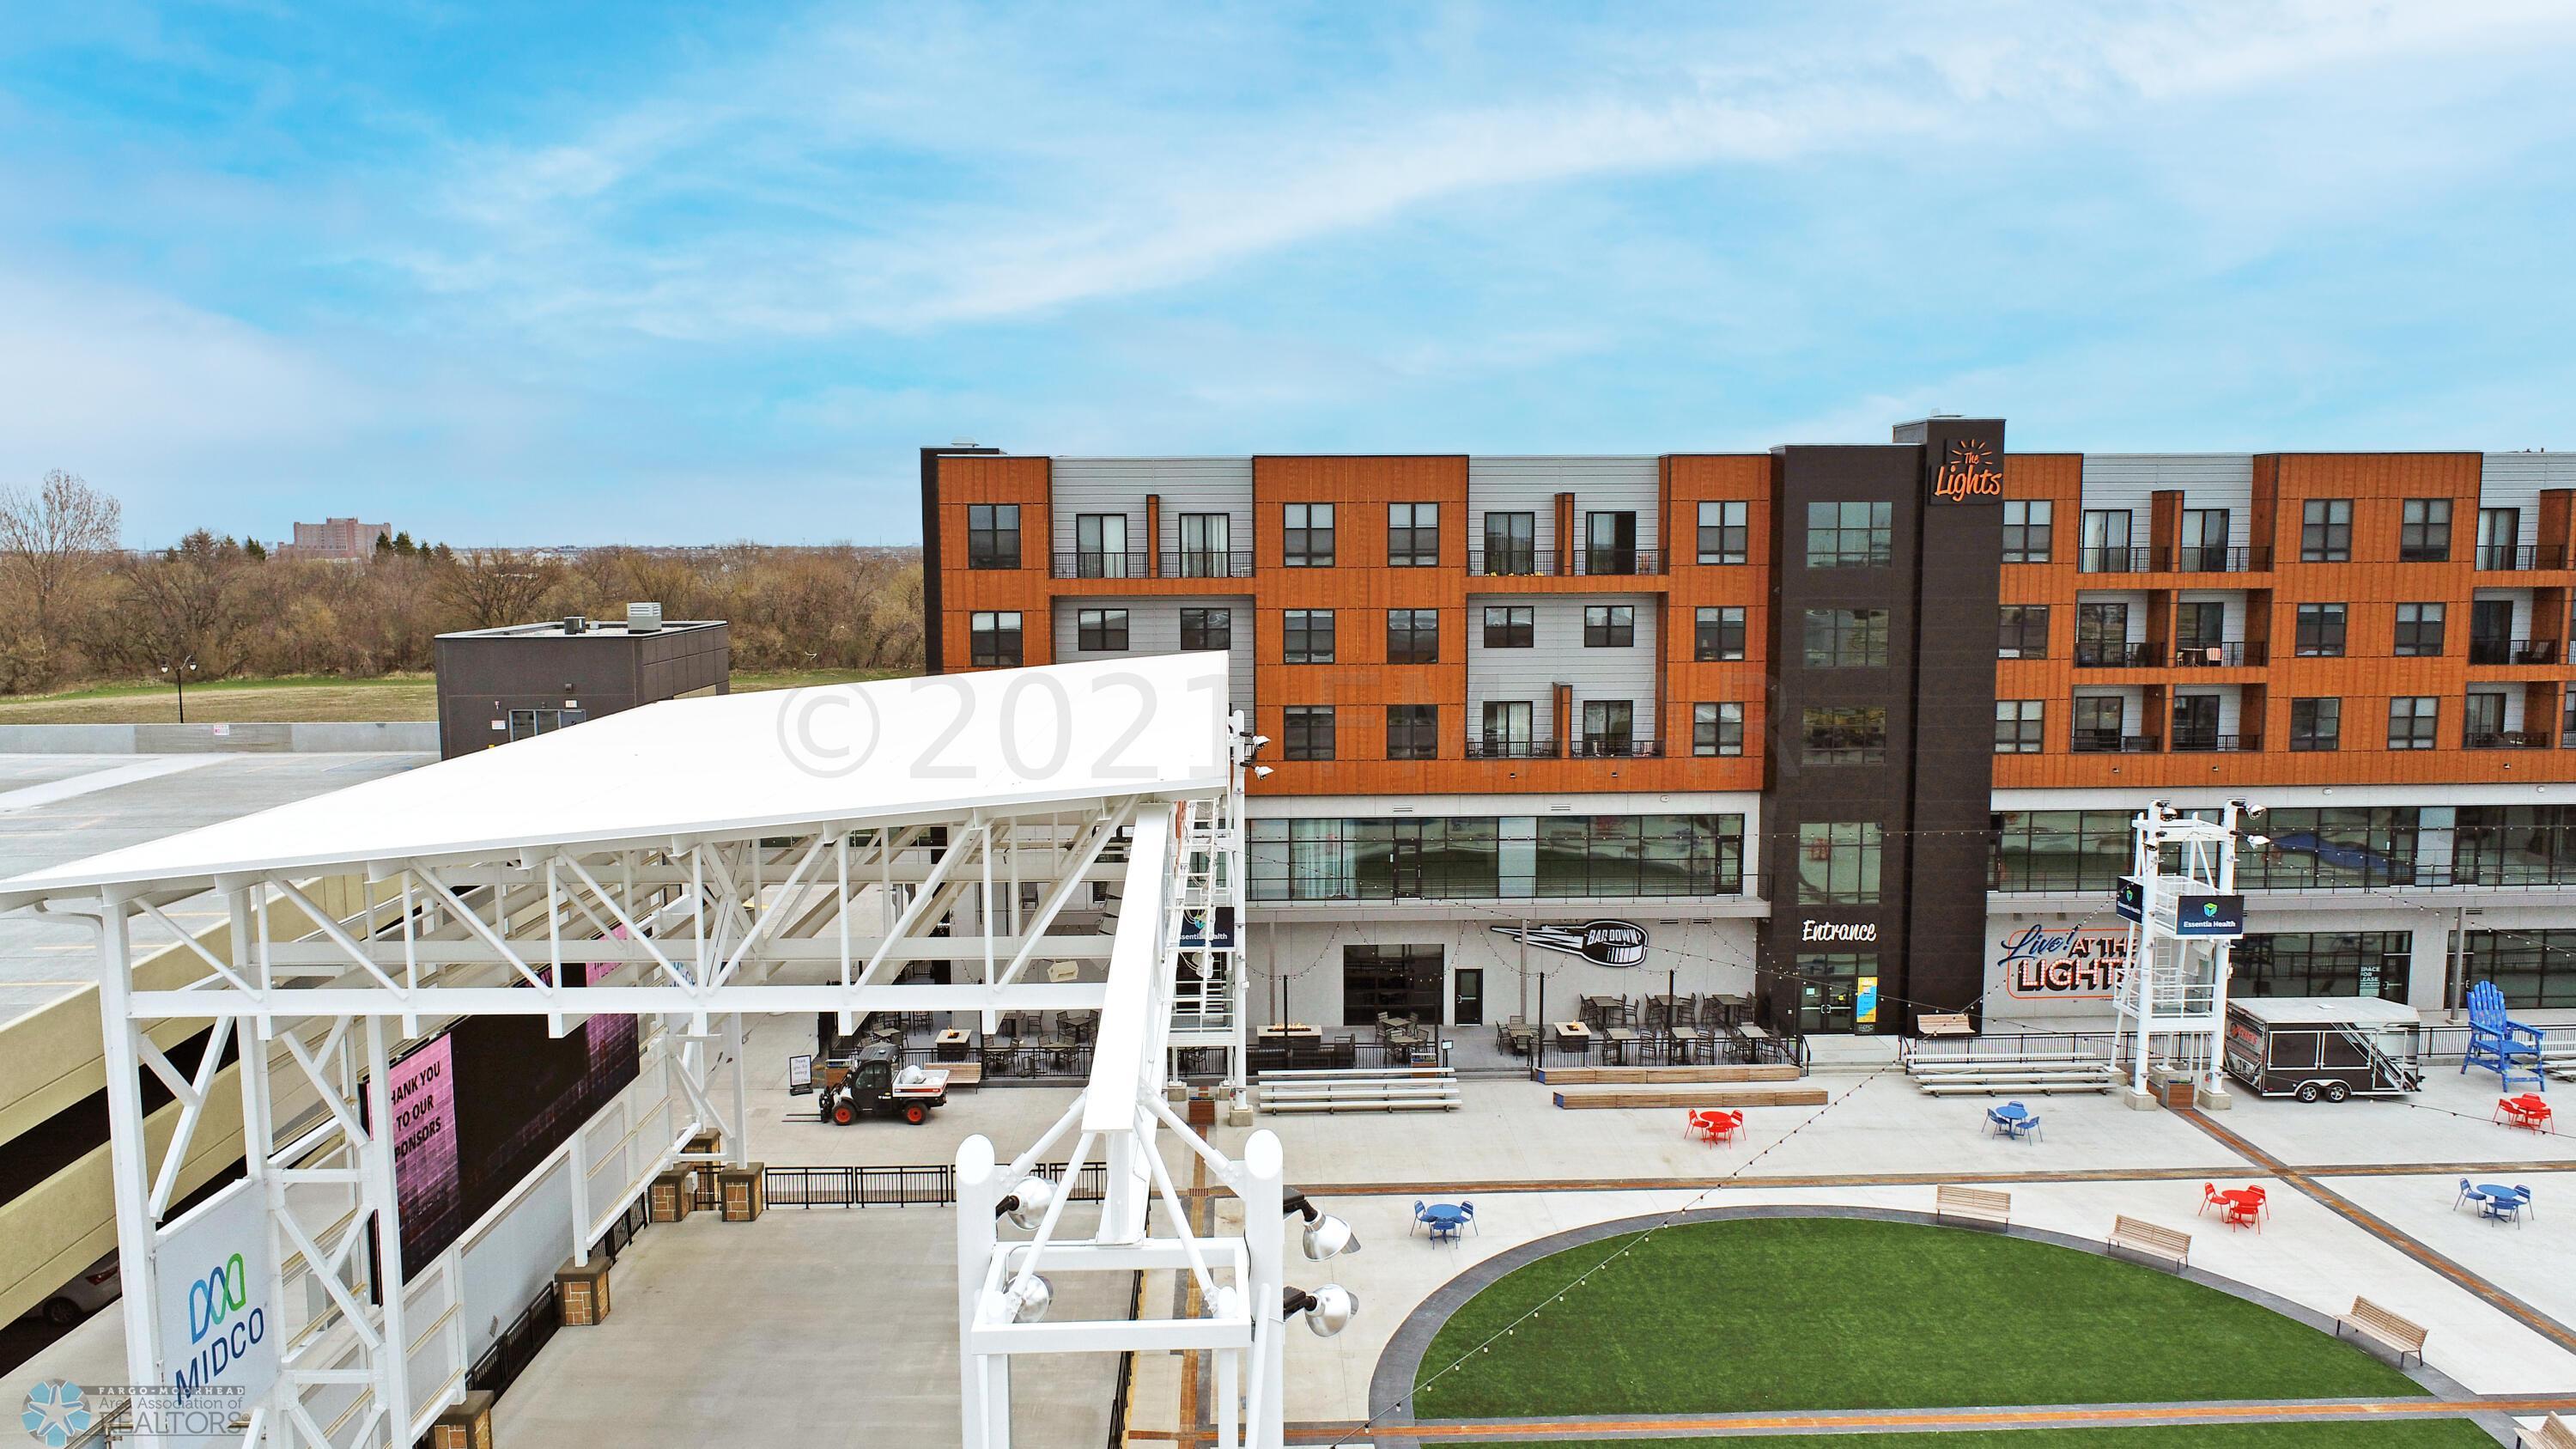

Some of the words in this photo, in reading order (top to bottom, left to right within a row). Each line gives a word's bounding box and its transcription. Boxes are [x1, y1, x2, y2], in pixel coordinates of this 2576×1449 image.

[1964, 451, 1980, 466] The
[1934, 465, 2002, 502] Lights
[1608, 929, 1639, 945] DOWN
[1801, 919, 1877, 942] Entrance
[1997, 923, 2081, 967] Live!
[2069, 937, 2096, 958] AT
[392, 1075, 419, 1106] HANK
[419, 1060, 440, 1087] YOU
[396, 1111, 410, 1132] TO
[412, 1093, 434, 1121] OUR
[395, 1116, 441, 1163] PONSORS
[174, 1306, 265, 1405] MIDCO
